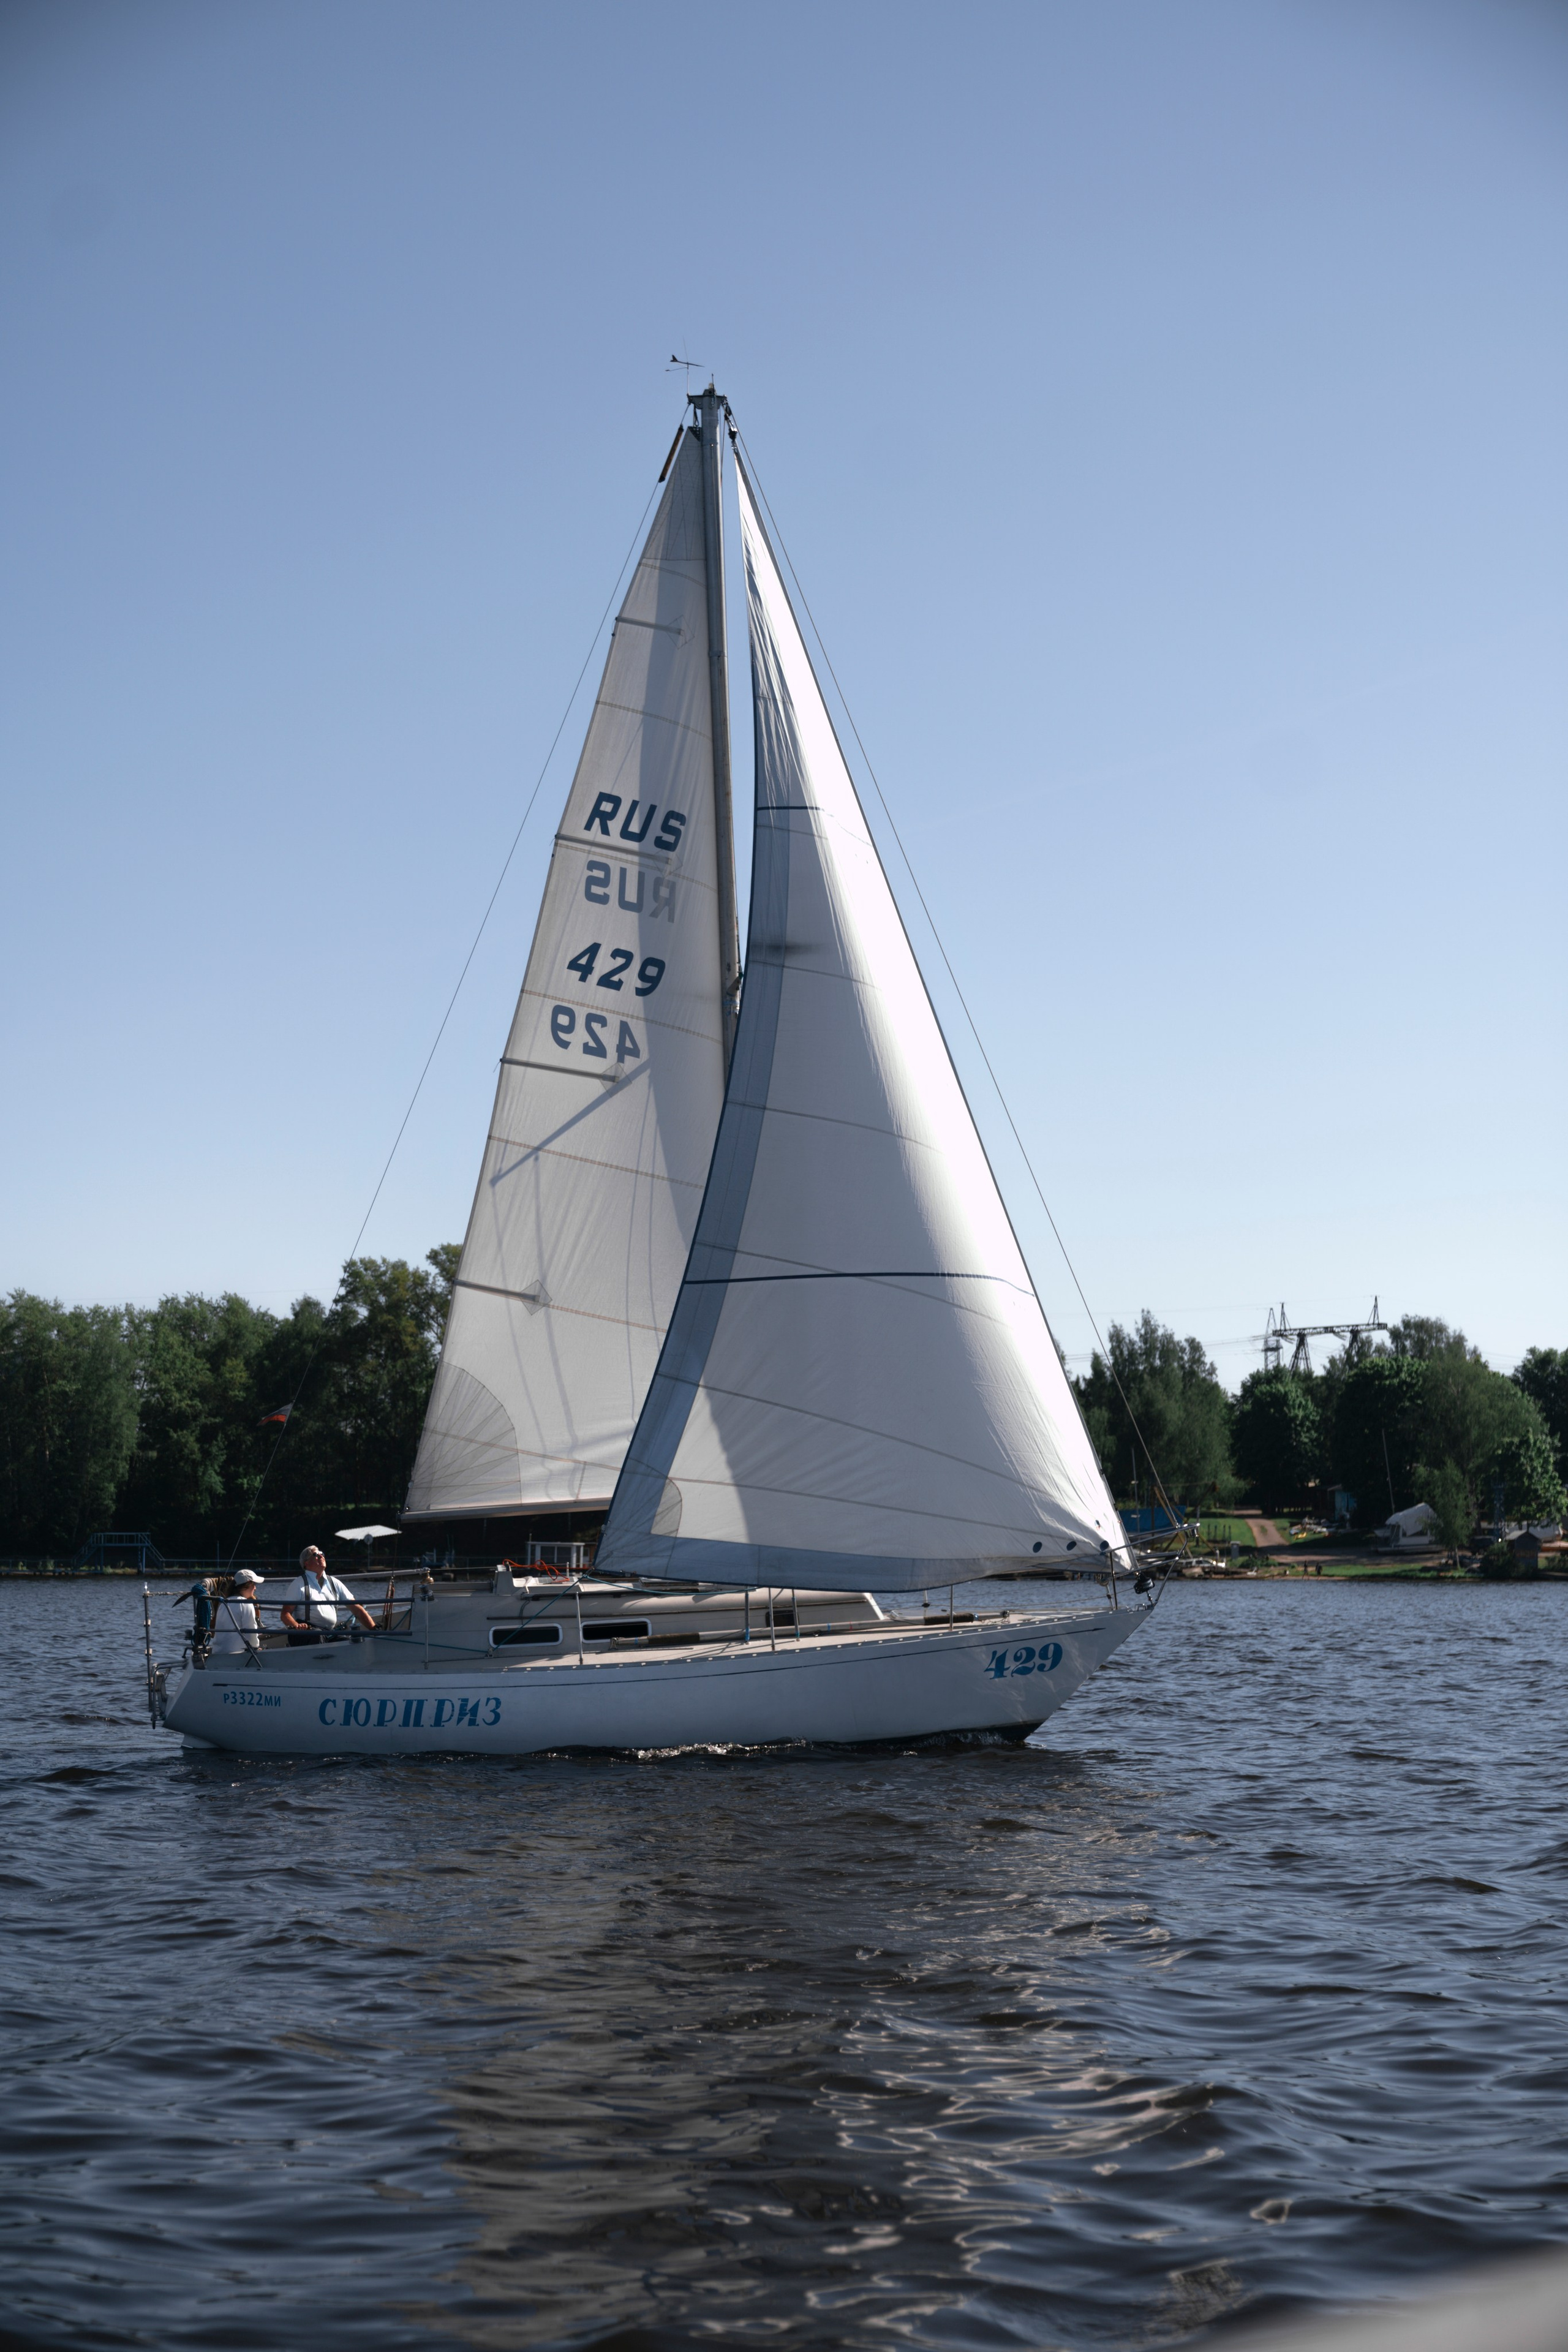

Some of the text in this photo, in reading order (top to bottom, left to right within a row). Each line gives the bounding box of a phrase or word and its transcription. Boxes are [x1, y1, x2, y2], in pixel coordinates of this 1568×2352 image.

[584, 791, 687, 852] RUS
[567, 942, 666, 997] 429
[984, 1642, 1063, 1680] 429
[223, 1691, 281, 1707] Р3322МИ
[318, 1697, 502, 1728] СЮРПРИЗ
